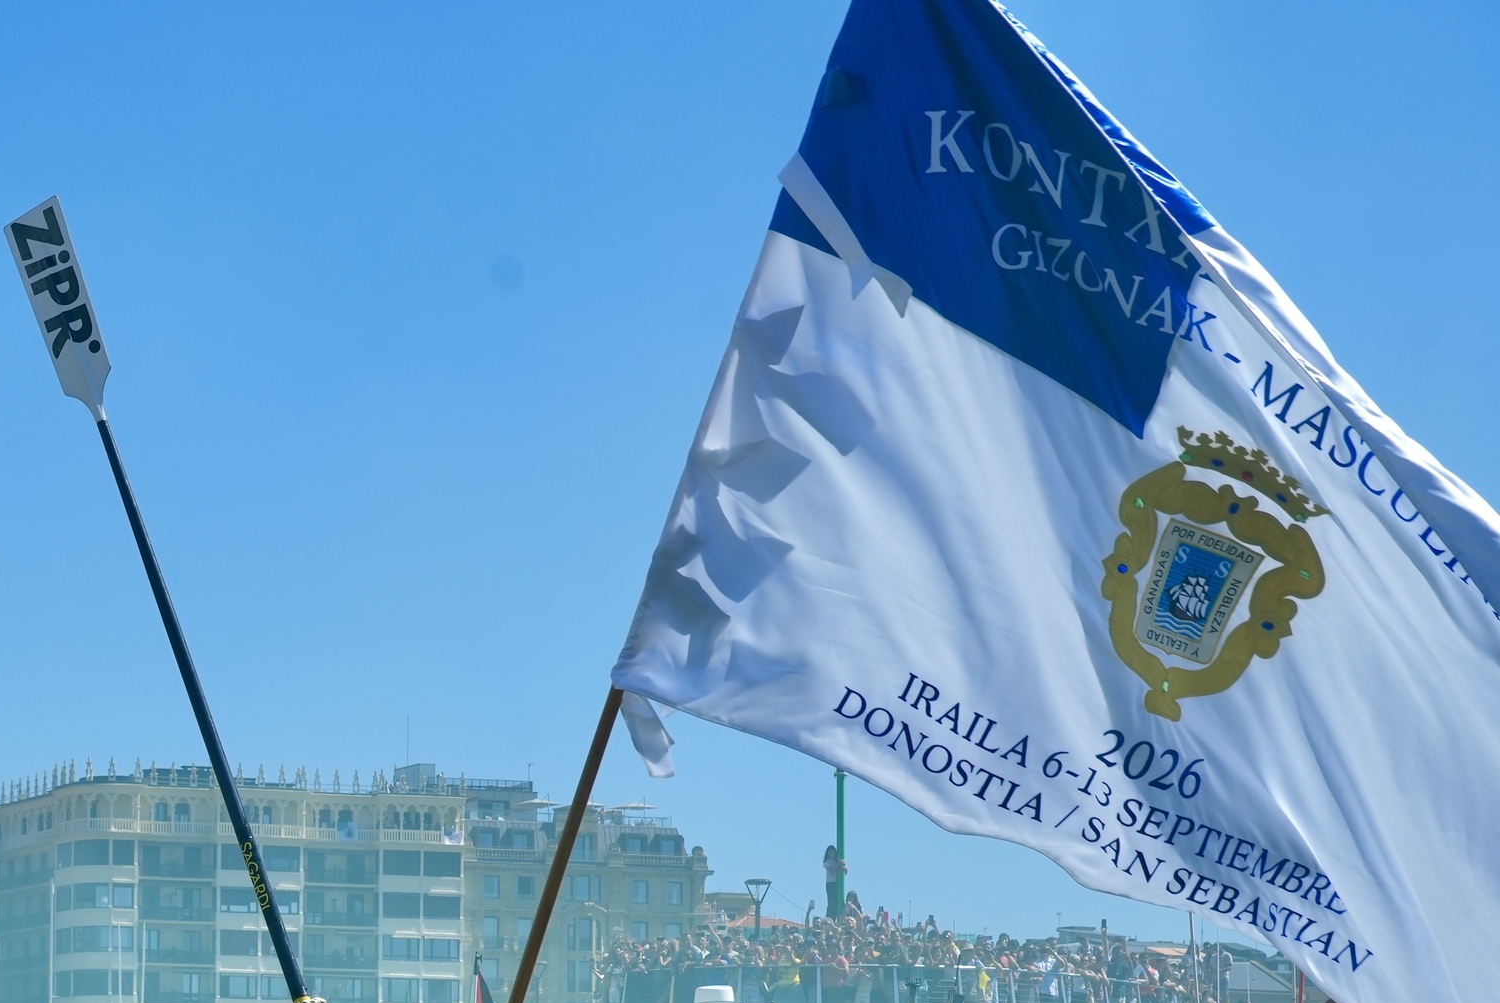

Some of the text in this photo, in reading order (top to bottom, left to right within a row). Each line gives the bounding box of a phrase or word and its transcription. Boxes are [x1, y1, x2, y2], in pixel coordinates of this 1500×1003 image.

[991, 223, 1216, 353] GIZONAK
[1171, 525, 1255, 564] POR FIDELIDAD
[1208, 578, 1243, 634] NOBLEZA
[1147, 629, 1200, 657] Y LEALTAD
[898, 673, 1348, 916] IRAILA 6-13 SEPTIEMBRE
[1095, 729, 1202, 800] 2026
[832, 686, 1045, 824] DONOSTIA
[1081, 815, 1170, 885] SAN
[1166, 867, 1374, 973] SEBASTIAN
[240, 842, 271, 911] SAGARDI
